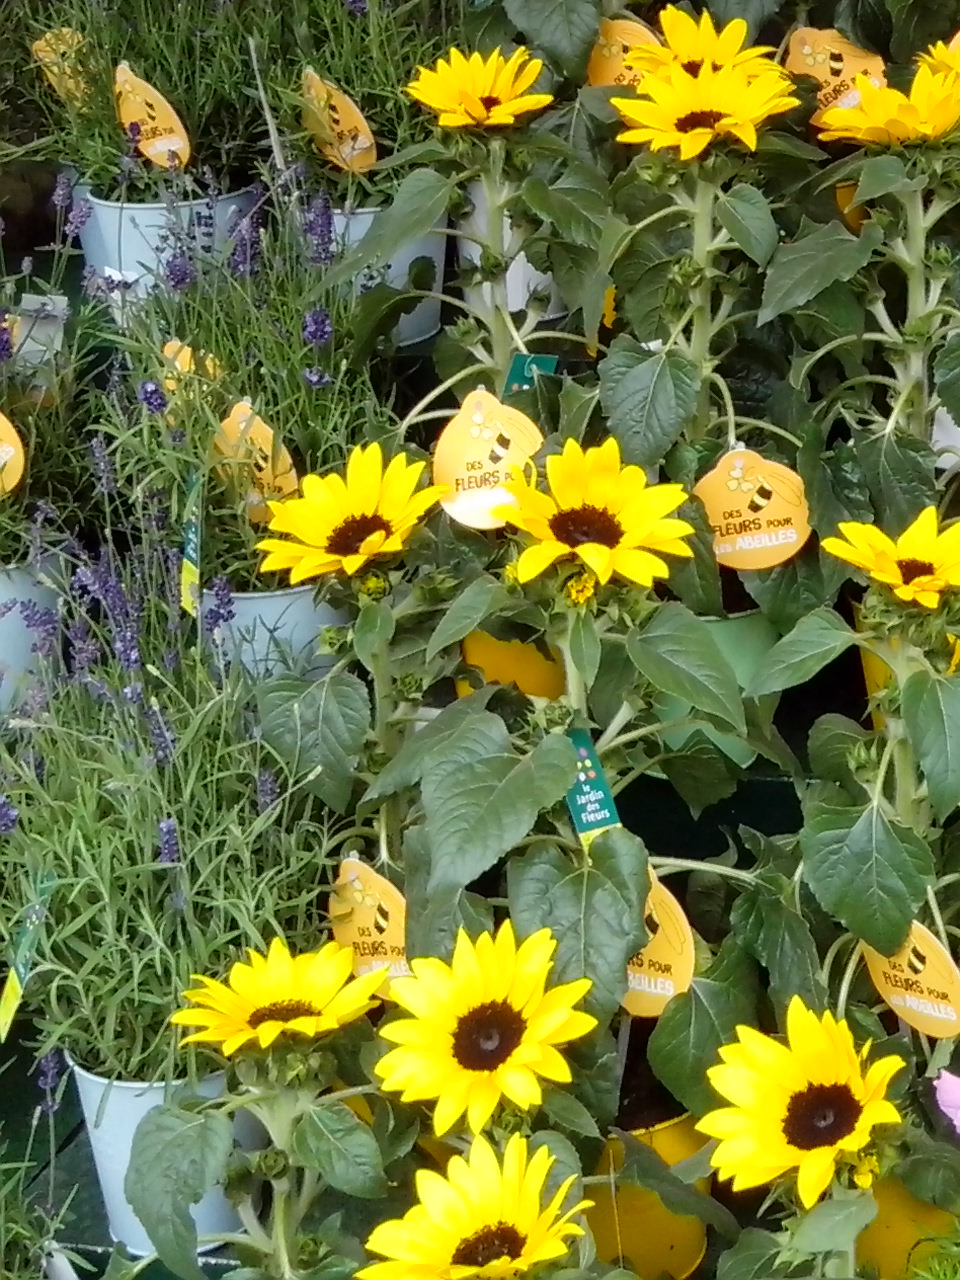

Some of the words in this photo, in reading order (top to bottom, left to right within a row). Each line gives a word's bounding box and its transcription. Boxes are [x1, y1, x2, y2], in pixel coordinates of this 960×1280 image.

[466, 460, 484, 472] DES
[455, 472, 501, 492] FLEURS
[723, 509, 742, 521] DES
[766, 516, 794, 529] POUR
[735, 529, 798, 552] ABEILLES
[580, 809, 611, 824] Fleurs
[352, 941, 388, 957] FLEURS
[648, 958, 673, 976] POUR
[881, 969, 924, 995] FLEURS
[926, 986, 952, 1004] POUR
